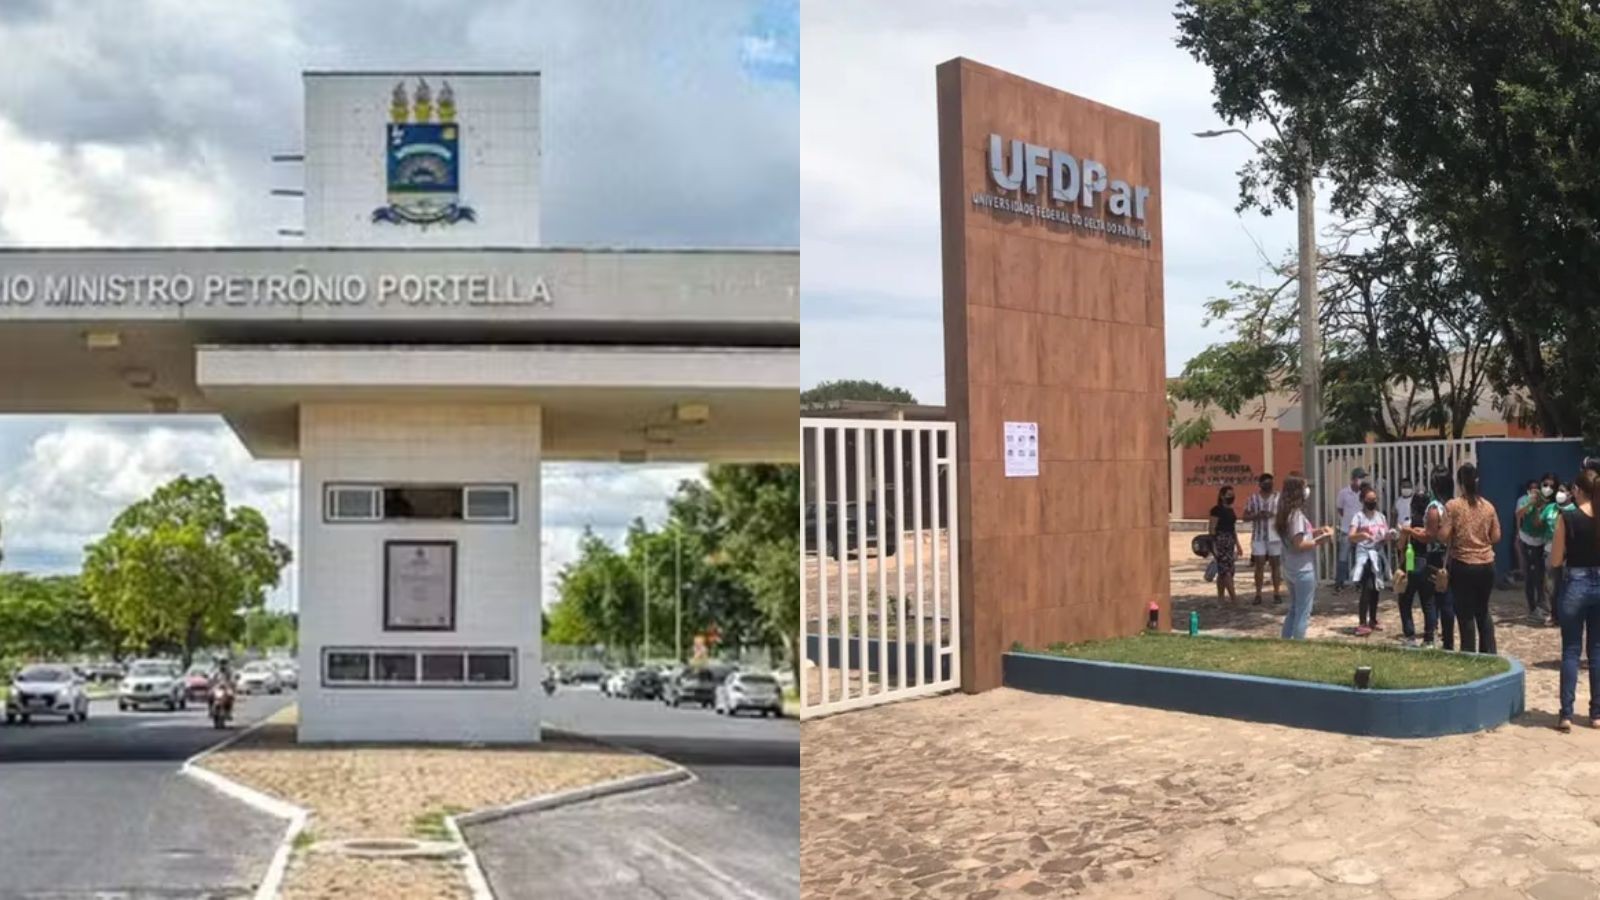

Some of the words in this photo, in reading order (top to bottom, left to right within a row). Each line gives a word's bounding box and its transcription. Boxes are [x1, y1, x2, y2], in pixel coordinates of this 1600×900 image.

[989, 134, 1150, 219] UFDPar
[973, 192, 1035, 216] UNIVERSIDADE
[1036, 205, 1071, 224] FEDERAL
[1072, 213, 1083, 226] DO
[1084, 216, 1105, 231] DELTA
[1106, 222, 1117, 234] DO
[43, 273, 196, 302] MINISTRO
[203, 265, 367, 302] PETRÔNIO
[377, 274, 551, 304] PORTELLA
